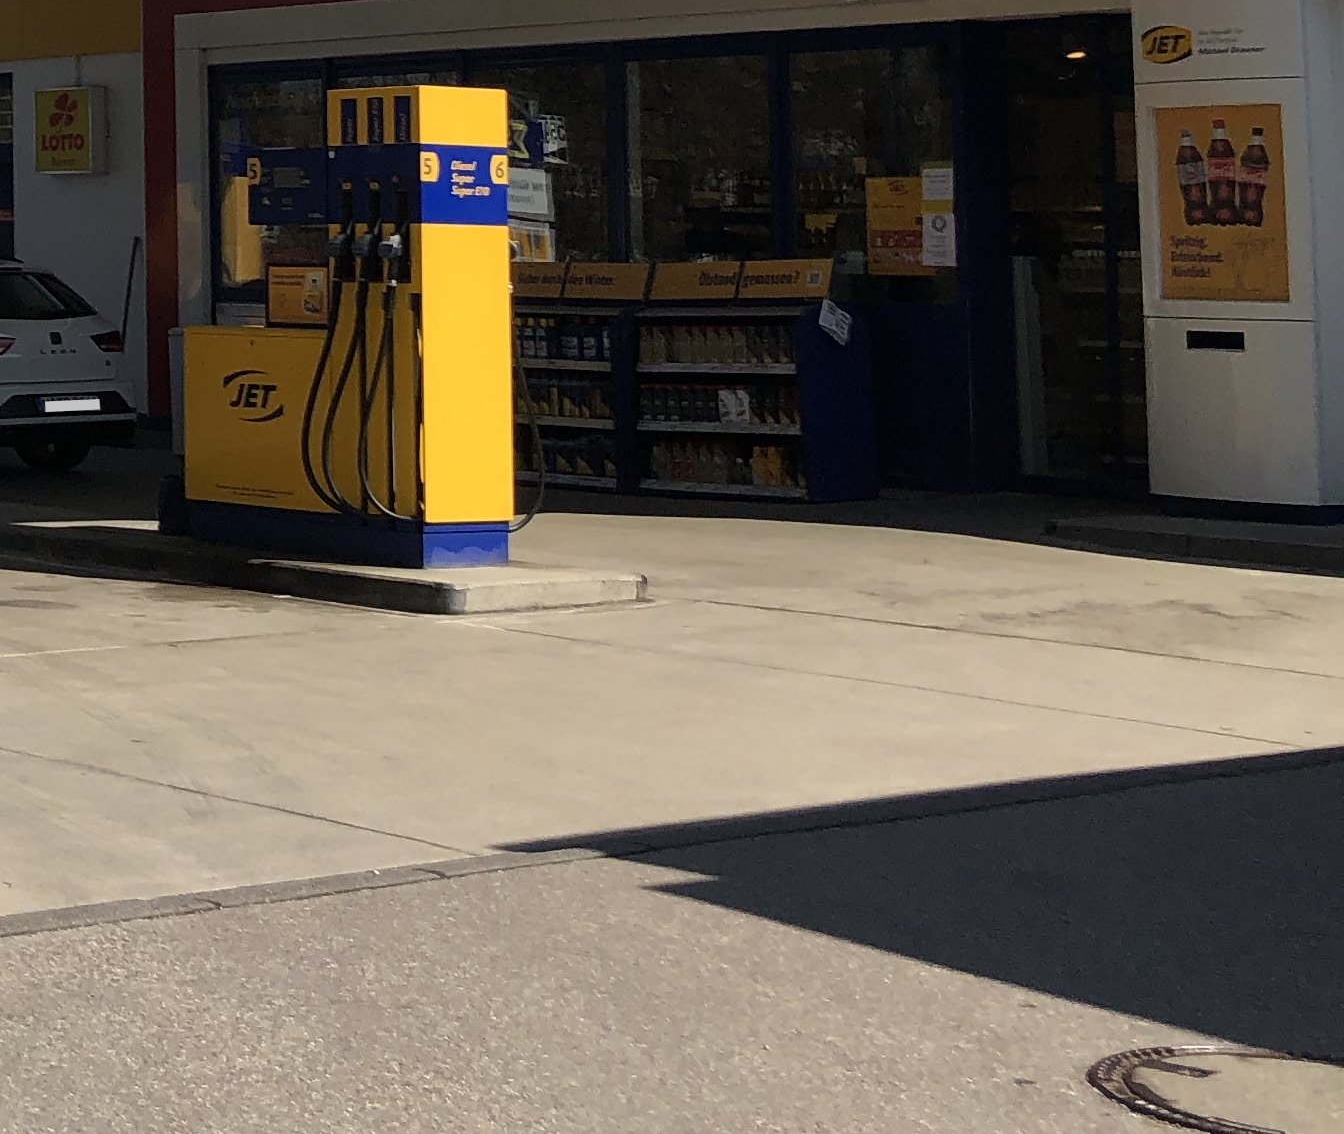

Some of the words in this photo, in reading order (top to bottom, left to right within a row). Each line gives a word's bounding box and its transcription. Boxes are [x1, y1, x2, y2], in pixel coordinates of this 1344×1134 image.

[1146, 34, 1186, 55] JET
[41, 133, 85, 152] LOTTO
[423, 158, 432, 175] 5
[495, 162, 504, 178] 6
[229, 383, 278, 409] JET
